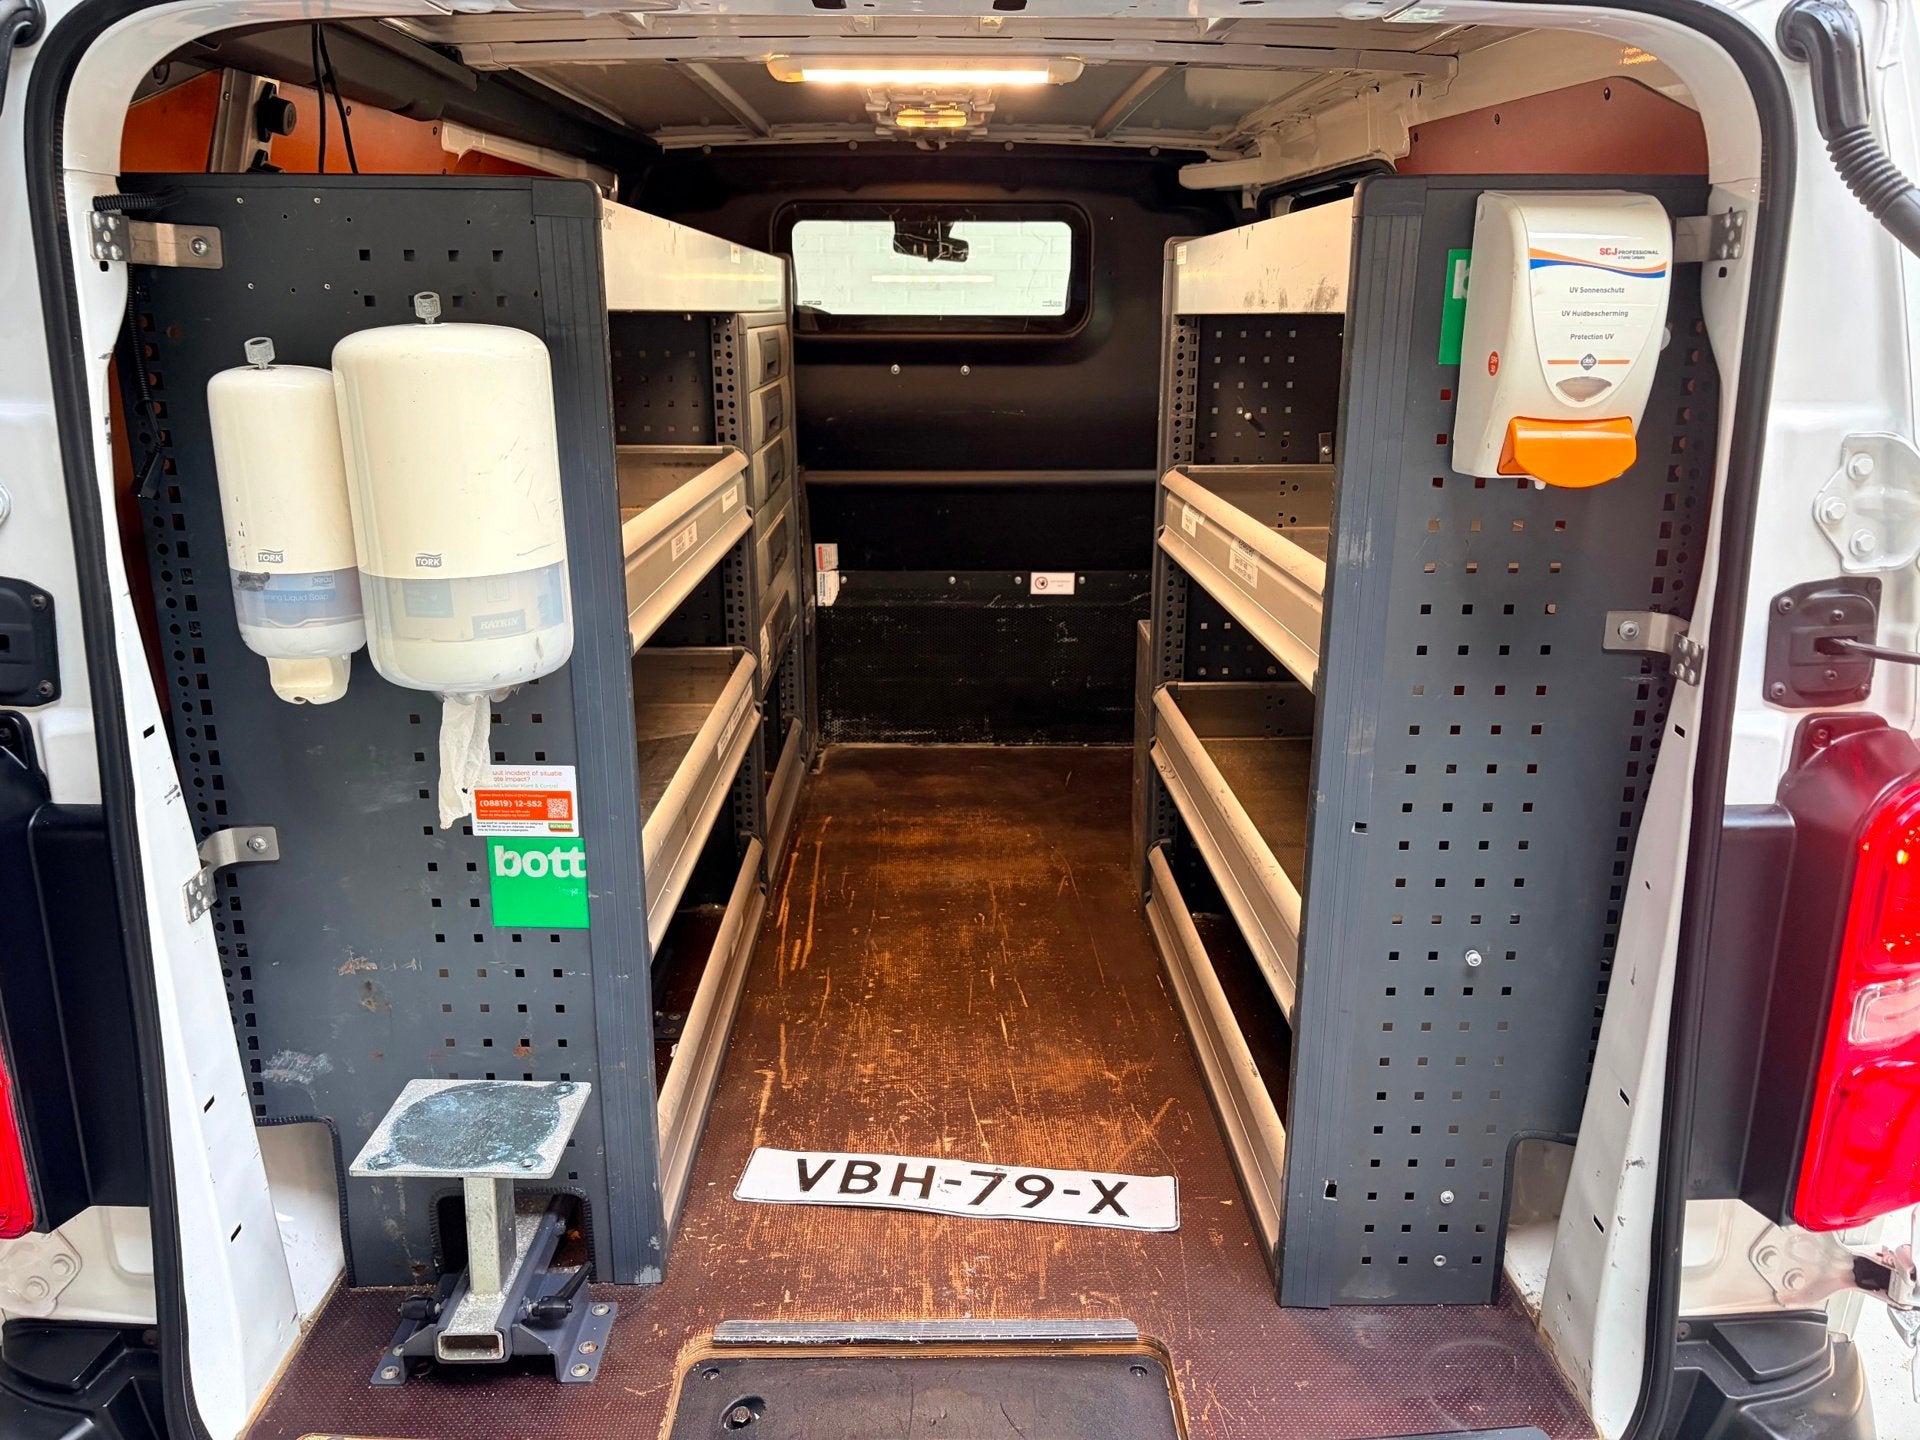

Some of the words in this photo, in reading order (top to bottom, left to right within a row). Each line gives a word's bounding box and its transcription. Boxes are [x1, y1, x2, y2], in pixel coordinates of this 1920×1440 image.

[1599, 247, 1618, 256] SCJ
[1579, 286, 1625, 294] Sonnenschutz
[1571, 310, 1629, 318] Huidbescherming
[258, 552, 283, 562] TORK
[416, 557, 442, 567] TORK
[480, 617, 519, 630] KATRIN
[480, 799, 512, 808] (08819)
[515, 800, 543, 808] 12-552
[494, 845, 586, 878] bott
[797, 1158, 1130, 1218] VBH-79-X
